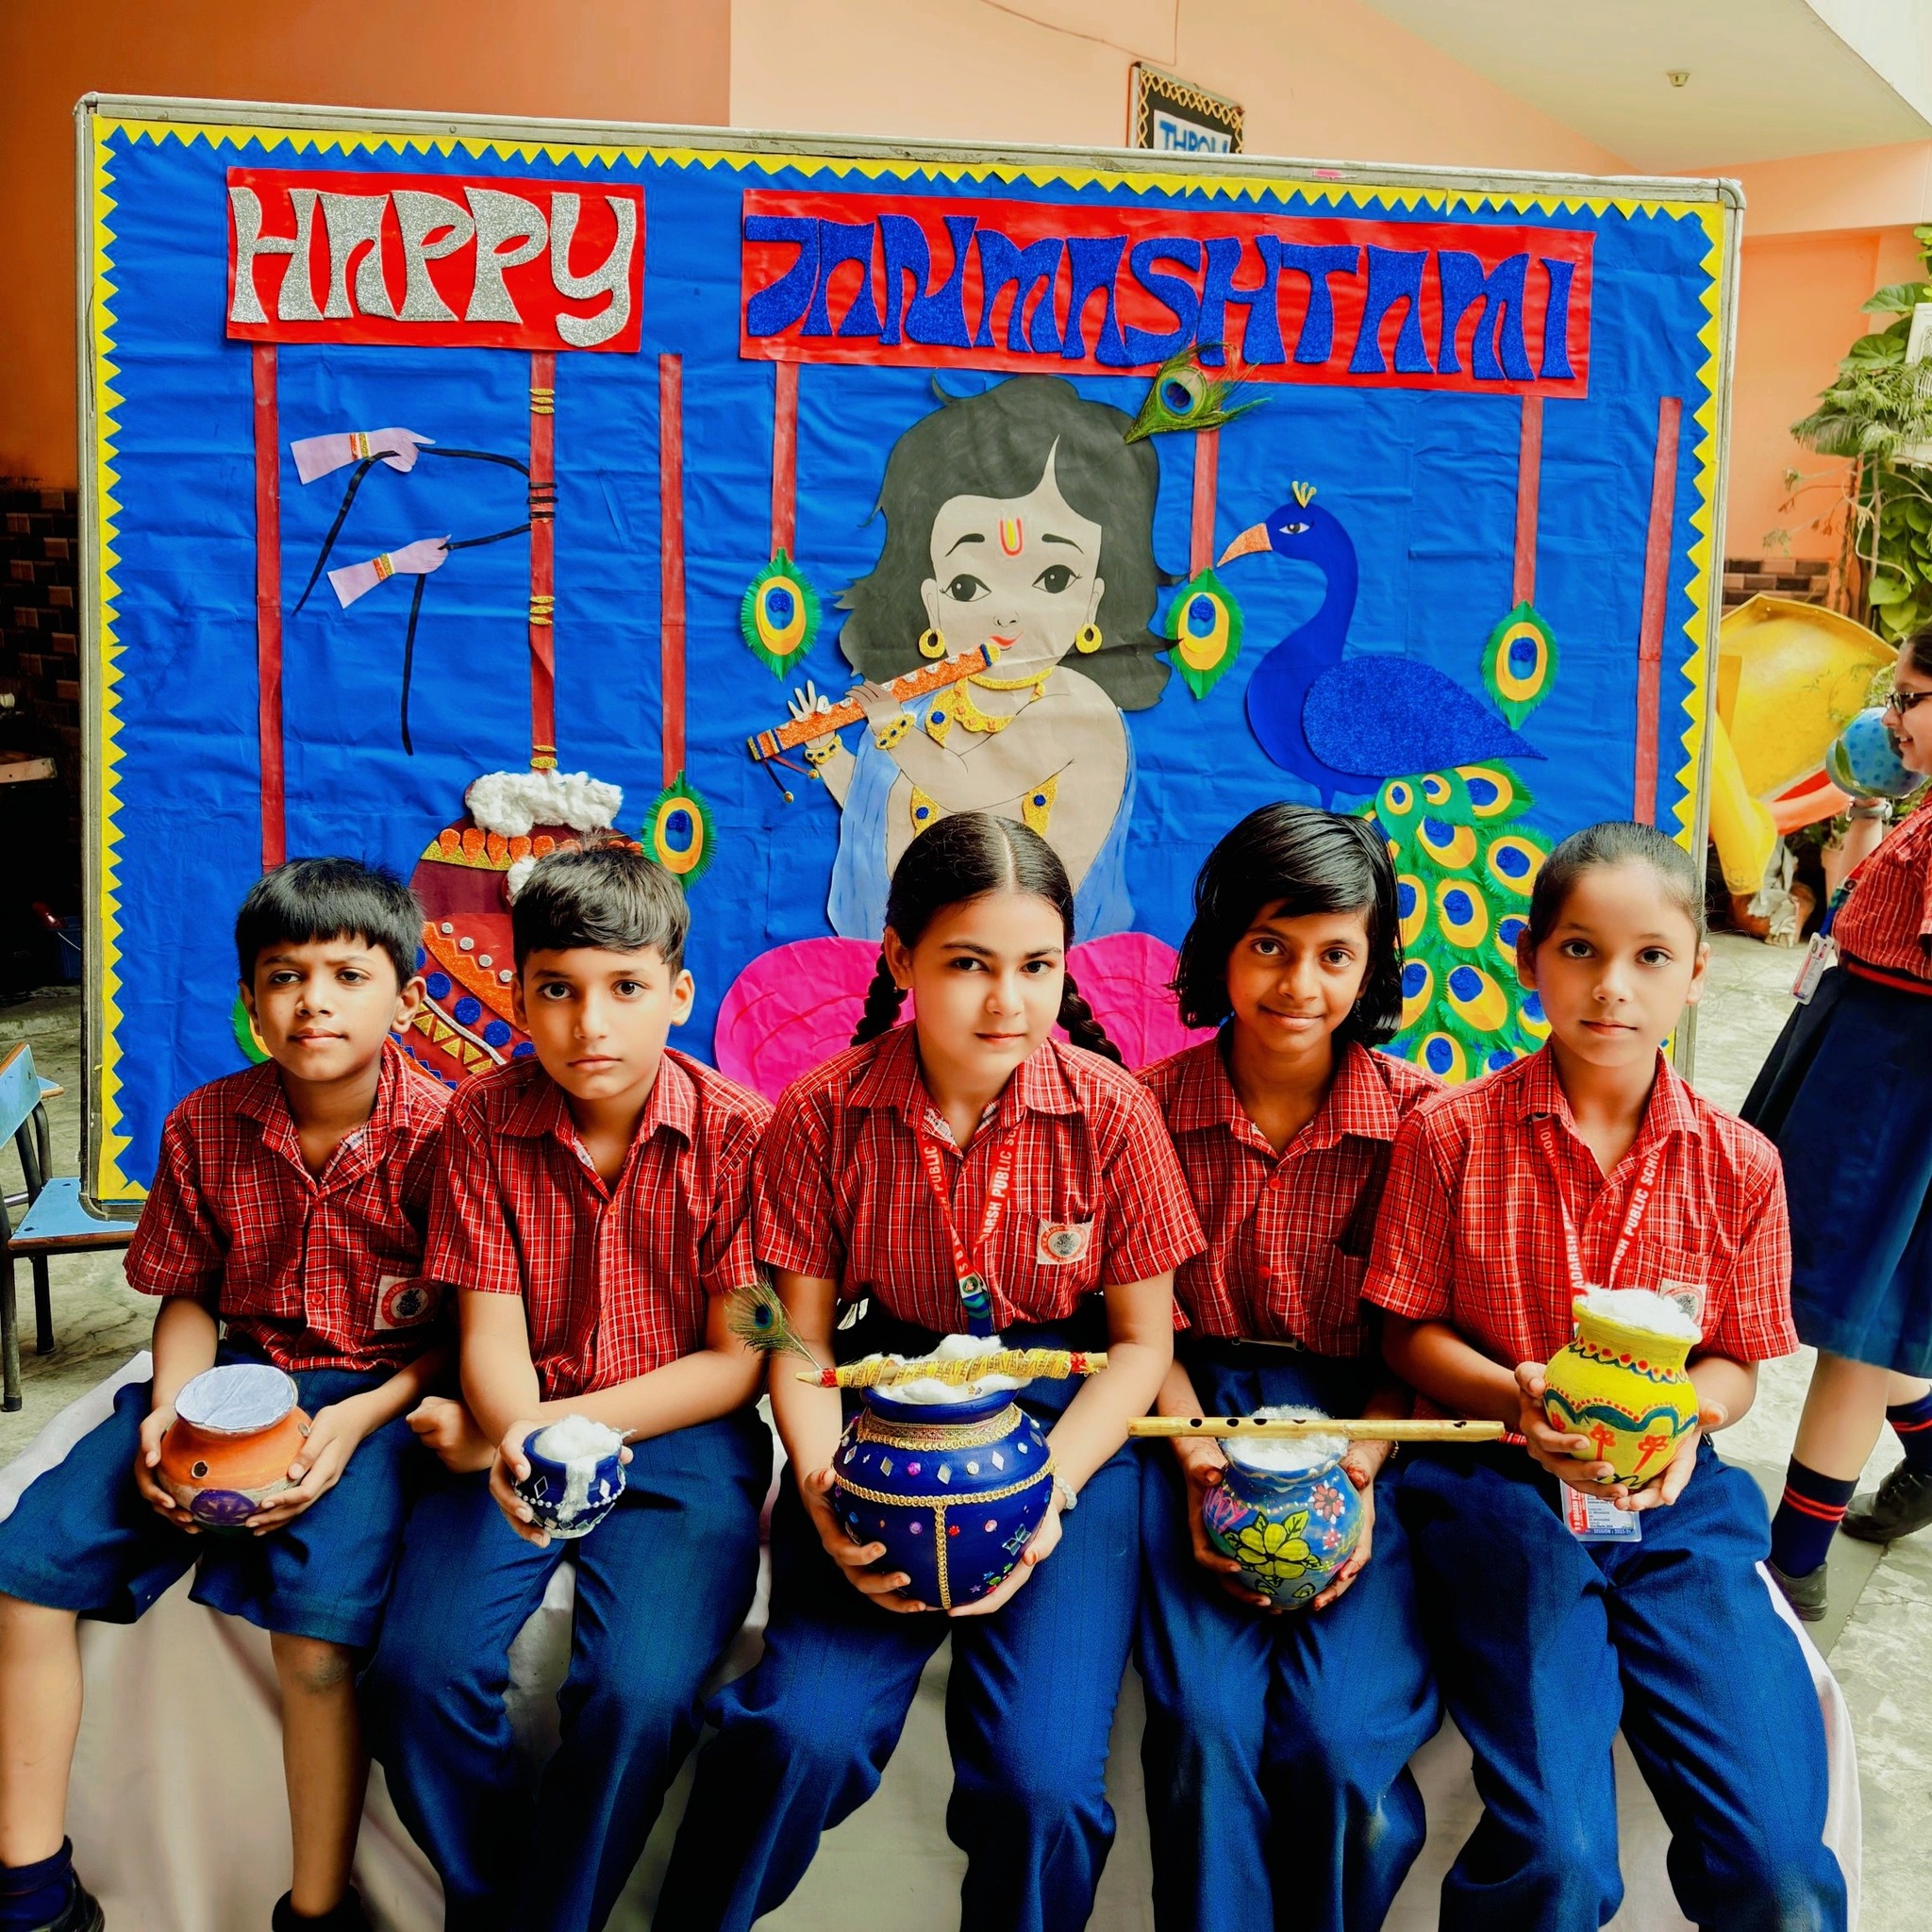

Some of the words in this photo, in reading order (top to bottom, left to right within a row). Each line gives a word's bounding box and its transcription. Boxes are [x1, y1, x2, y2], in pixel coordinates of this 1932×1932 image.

[228, 186, 636, 348] HAPPY
[745, 212, 1578, 382] JANMASHTAMI
[924, 1145, 944, 1191] PUBLIC
[1540, 1125, 1557, 1171] CHOOL
[991, 1150, 1013, 1198] PUBLIC
[1624, 1189, 1649, 1237] PUBLIC
[1566, 1235, 1586, 1290] ADARSH
